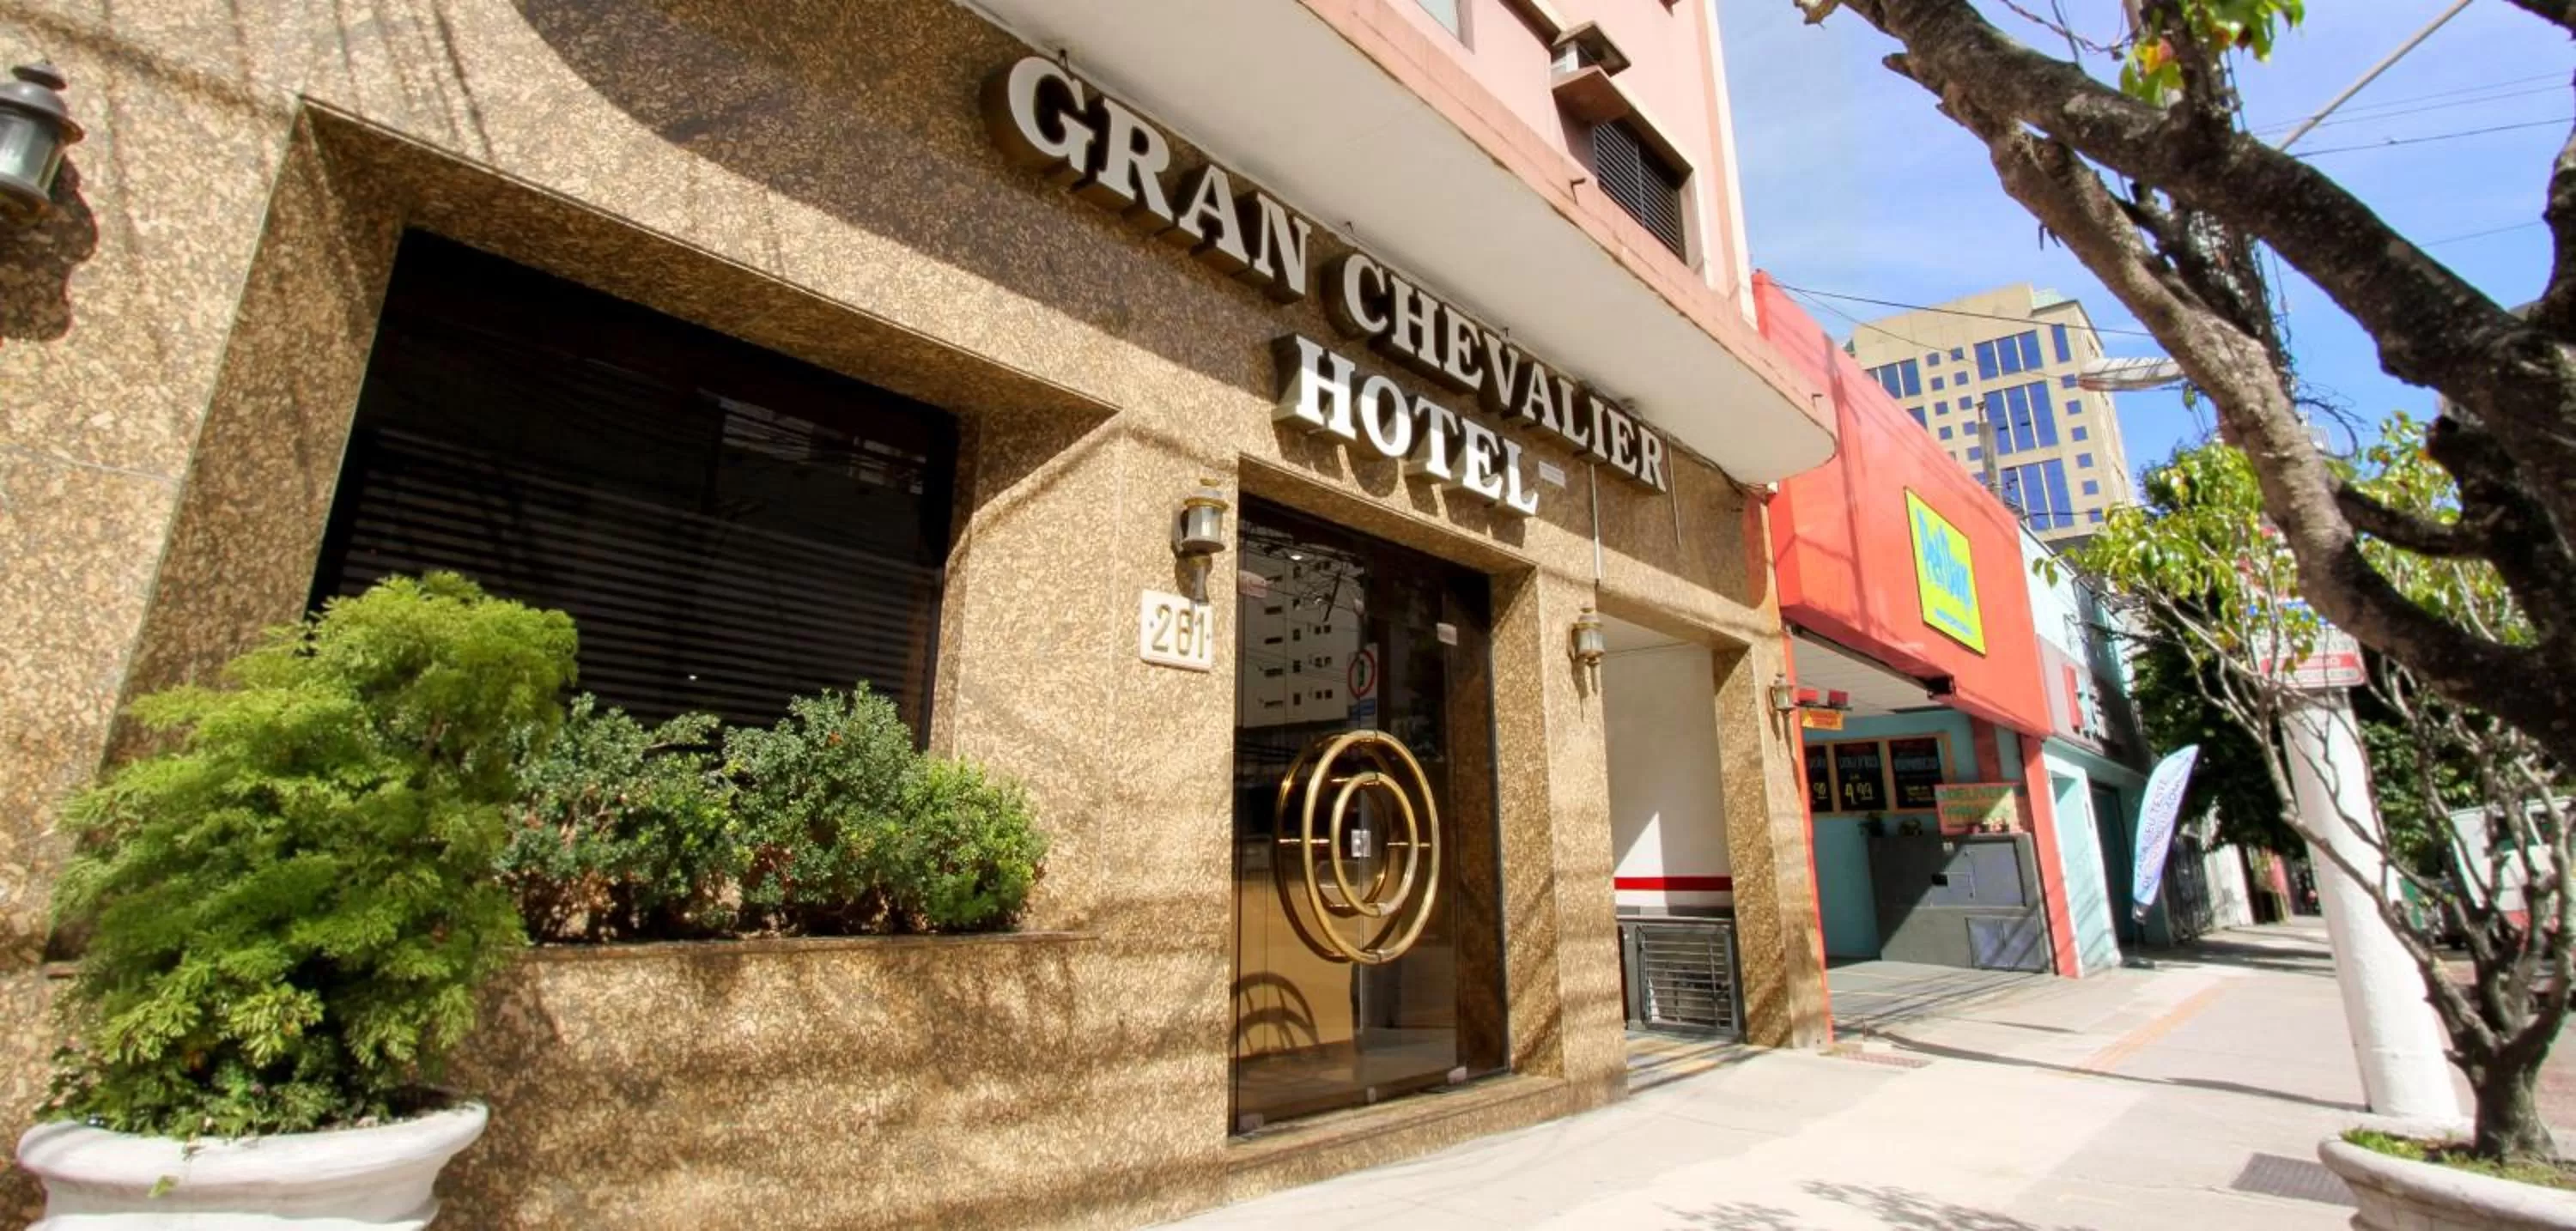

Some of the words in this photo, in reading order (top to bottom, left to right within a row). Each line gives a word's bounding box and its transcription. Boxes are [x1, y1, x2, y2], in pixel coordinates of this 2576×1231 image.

[1006, 56, 1312, 297] GRAN
[1342, 252, 1668, 494] CHEVALIER
[1293, 335, 1540, 516] HOTEL
